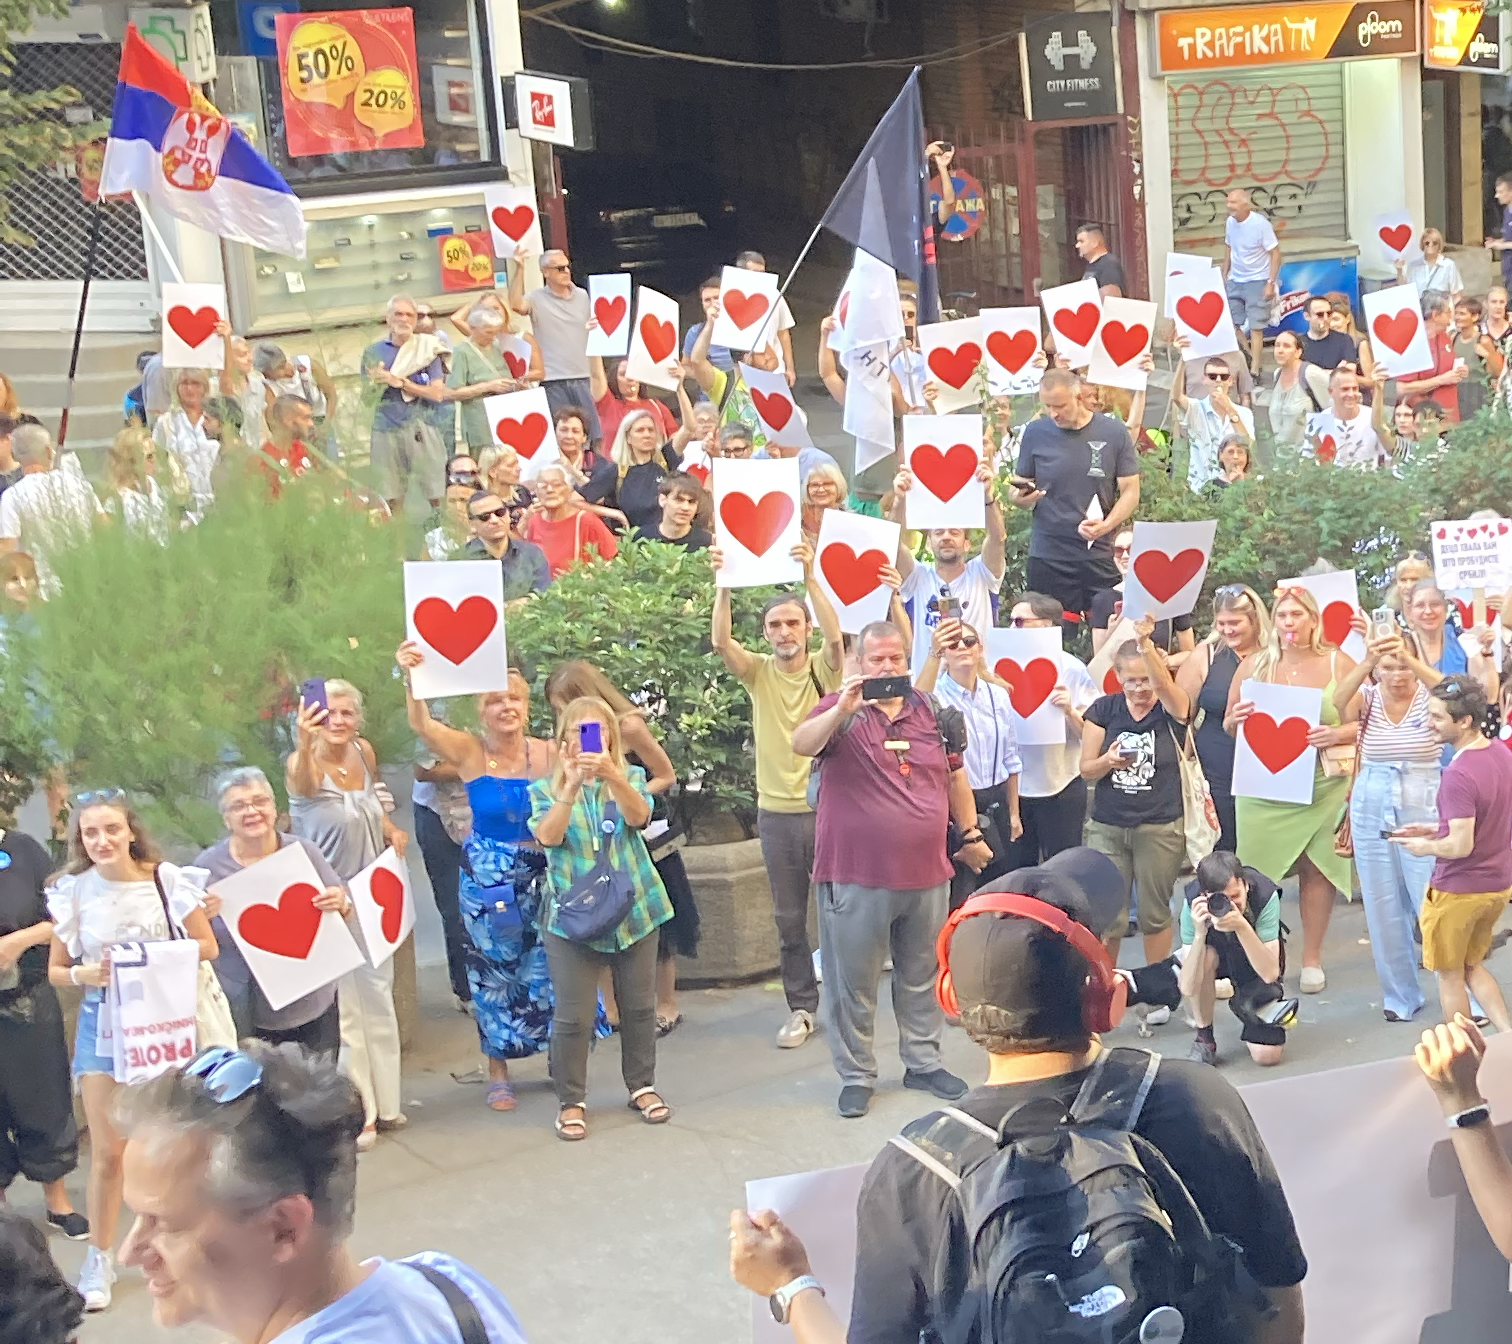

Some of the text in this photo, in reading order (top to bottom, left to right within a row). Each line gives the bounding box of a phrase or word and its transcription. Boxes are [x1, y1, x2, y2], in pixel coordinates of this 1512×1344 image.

[296, 40, 355, 84] 50%
[1046, 77, 1100, 92] CITY FITNESS
[360, 88, 406, 110] 20%
[929, 197, 985, 214] ГАЖА
